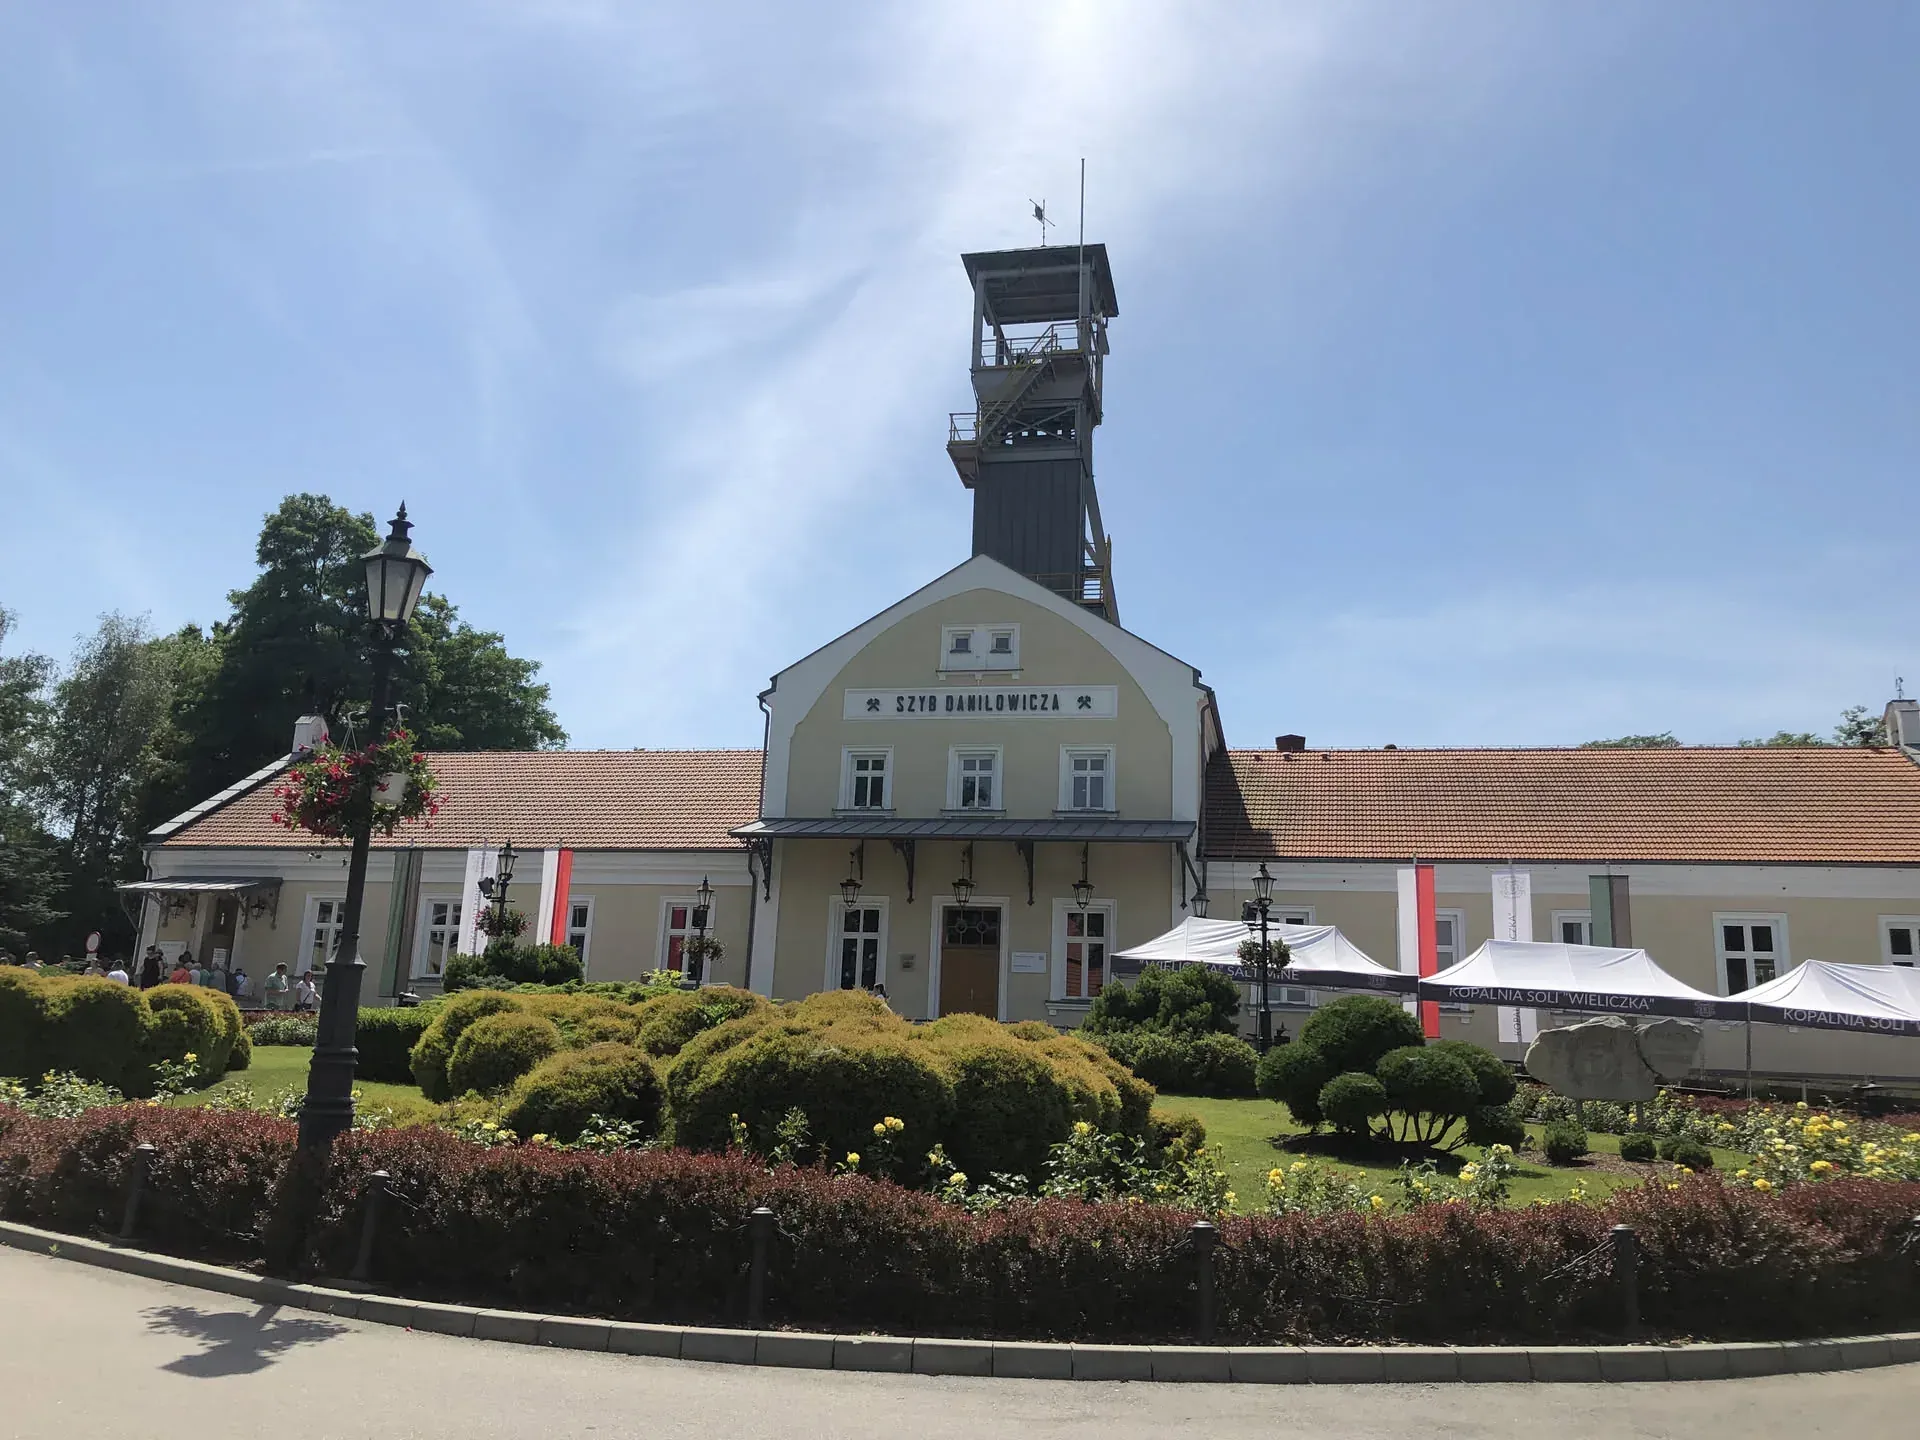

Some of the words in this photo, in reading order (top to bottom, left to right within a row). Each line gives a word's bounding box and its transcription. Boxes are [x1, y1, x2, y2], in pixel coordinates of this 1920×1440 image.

[896, 695, 937, 713] SZYB
[1449, 987, 1524, 1001] KOPALNIA
[1527, 990, 1559, 1004] SOLI
[1563, 992, 1655, 1010] "WIELICZKA"
[1784, 1008, 1865, 1027] KOPALNIA
[1869, 1017, 1905, 1030] SOLI
